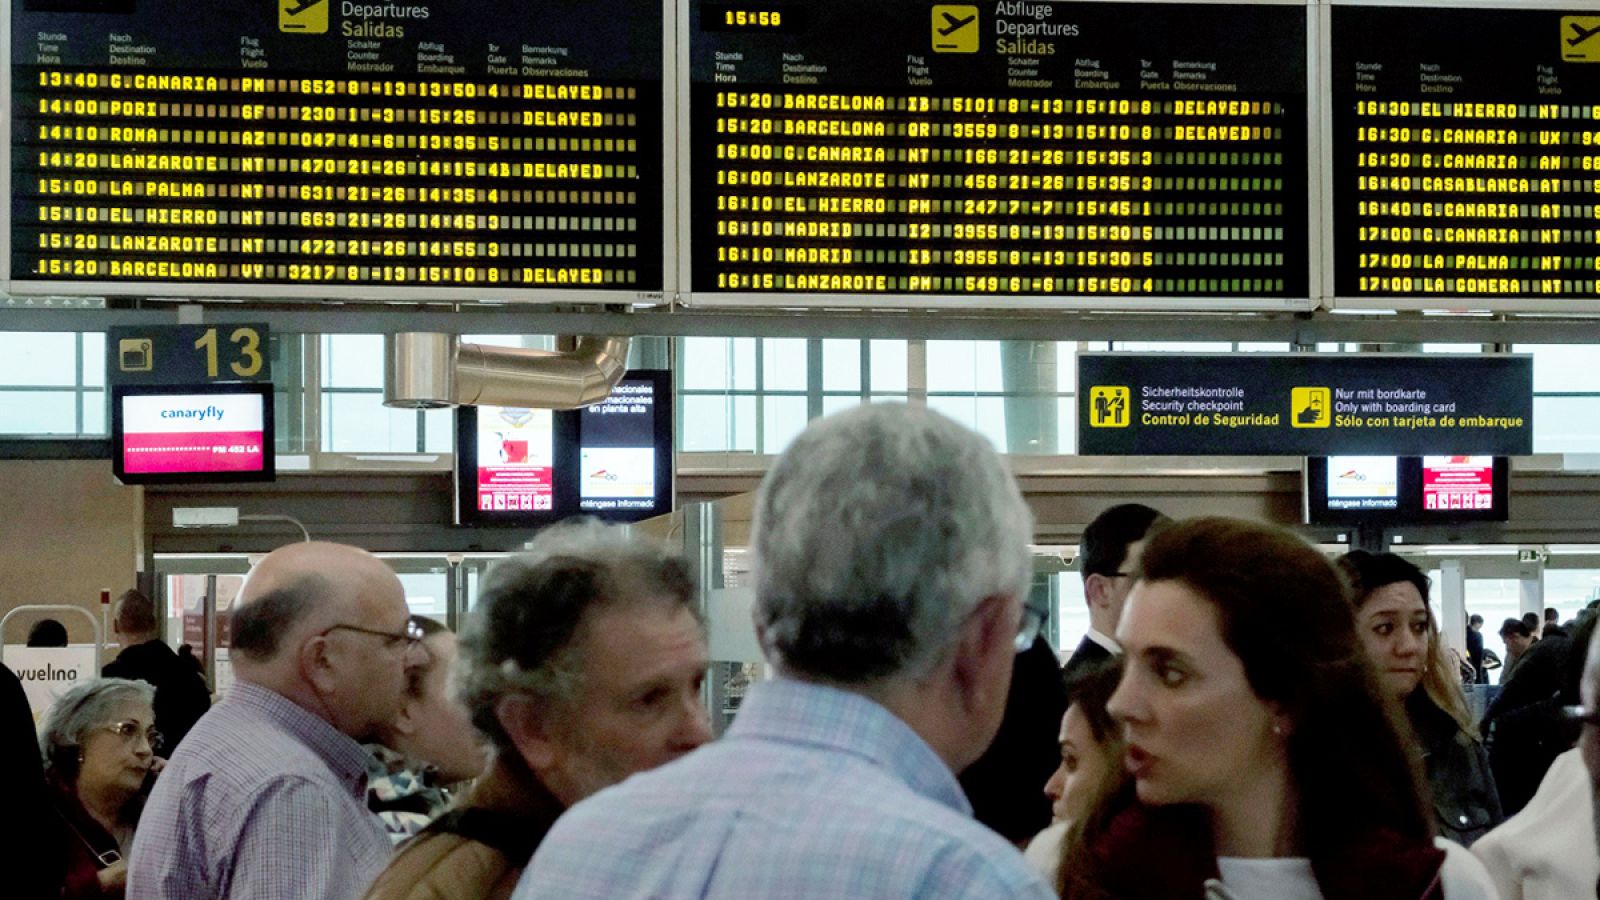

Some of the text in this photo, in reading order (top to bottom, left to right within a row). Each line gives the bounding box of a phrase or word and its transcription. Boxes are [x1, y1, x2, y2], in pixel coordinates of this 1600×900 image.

[341, 1, 429, 20] Departures
[726, 11, 781, 26] 15:58
[995, 1, 1053, 20] Abfluge
[38, 32, 67, 41] Stunde
[109, 33, 132, 42] Nach
[342, 20, 404, 38] Salidas
[996, 20, 1080, 38] Departures
[996, 38, 1056, 55] Salidas
[37, 54, 60, 64] Hora
[109, 55, 146, 65] Destino
[347, 51, 380, 60] Counter
[417, 52, 454, 64] Boarding
[487, 54, 507, 64] Gate
[347, 62, 394, 72] Mostrador
[417, 63, 465, 75] Embarque
[487, 65, 518, 75] Puerta
[522, 66, 589, 78] Observaciones
[715, 62, 736, 72] Time
[40, 72, 602, 100] 13:40 G.CANARIA PM 652 13:50 DELAYED
[715, 73, 737, 83] Hora
[717, 92, 1129, 114] 15:20 BARCELONA IB 5101 15:10
[1358, 101, 1517, 118] 16:30 EL HIERRO
[39, 99, 602, 126] 14:00 PORI 230 15:25 DELAYED
[717, 118, 1130, 140] 15:20 BARCELONA 3559 15:10
[1358, 127, 1517, 144] 16:30 G.CANARIA
[40, 126, 476, 150] 14:10 ROMA AZ 047 13:35
[717, 144, 1130, 165] 16:00 G.CANARIA 166 21-26 15:35
[1359, 152, 1517, 169] 16:30 G.CANARIA
[40, 152, 602, 178] 14:20 LANZAROTE 470 21-26 14:15 4B DELAYED
[718, 170, 1130, 191] 16:00 LANZAROTE 456 21-26 15:35
[1359, 176, 1529, 193] 16:40 CASABLANCA
[39, 179, 475, 203] 15:00 LA PALMA 631 21-26 14:35
[718, 195, 1130, 216] 16:10 EL HIERRO PM 247 15:45
[1359, 201, 1518, 218] 16:40 G.CANARIA
[39, 206, 475, 229] 15:10 EL HIERRO 663 21-26 14:45
[718, 220, 1131, 241] 16:10 MADRID 3955 15:30
[1359, 227, 1519, 243] 17:00 G.CANARIA
[40, 233, 475, 257] 15:20 LANZAROTE 472 21-26 14:55
[718, 247, 1131, 266] 16:10 MADRID IB 3955 15:30
[1359, 254, 1509, 269] 17:00 LA PALMA
[39, 259, 602, 283] 15:20 BARCELONA VY 3217 15:10 DELAYED
[718, 273, 1131, 293] 16:15 LANZAROTE PM 549 15:50
[1359, 277, 1520, 293] 17:00 LA GOMERA
[194, 327, 263, 377] 13
[1142, 386, 1245, 397] Sicherheitskontrolle
[1335, 388, 1426, 399] Nur mit bordkarte
[160, 406, 225, 420] canaryfly
[1142, 400, 1244, 412] Security checkpoint
[1335, 401, 1456, 414] Only with boarding card
[1142, 413, 1279, 428] Control de Seguridad
[1335, 415, 1523, 429] Sólo con tarjeta de embarque
